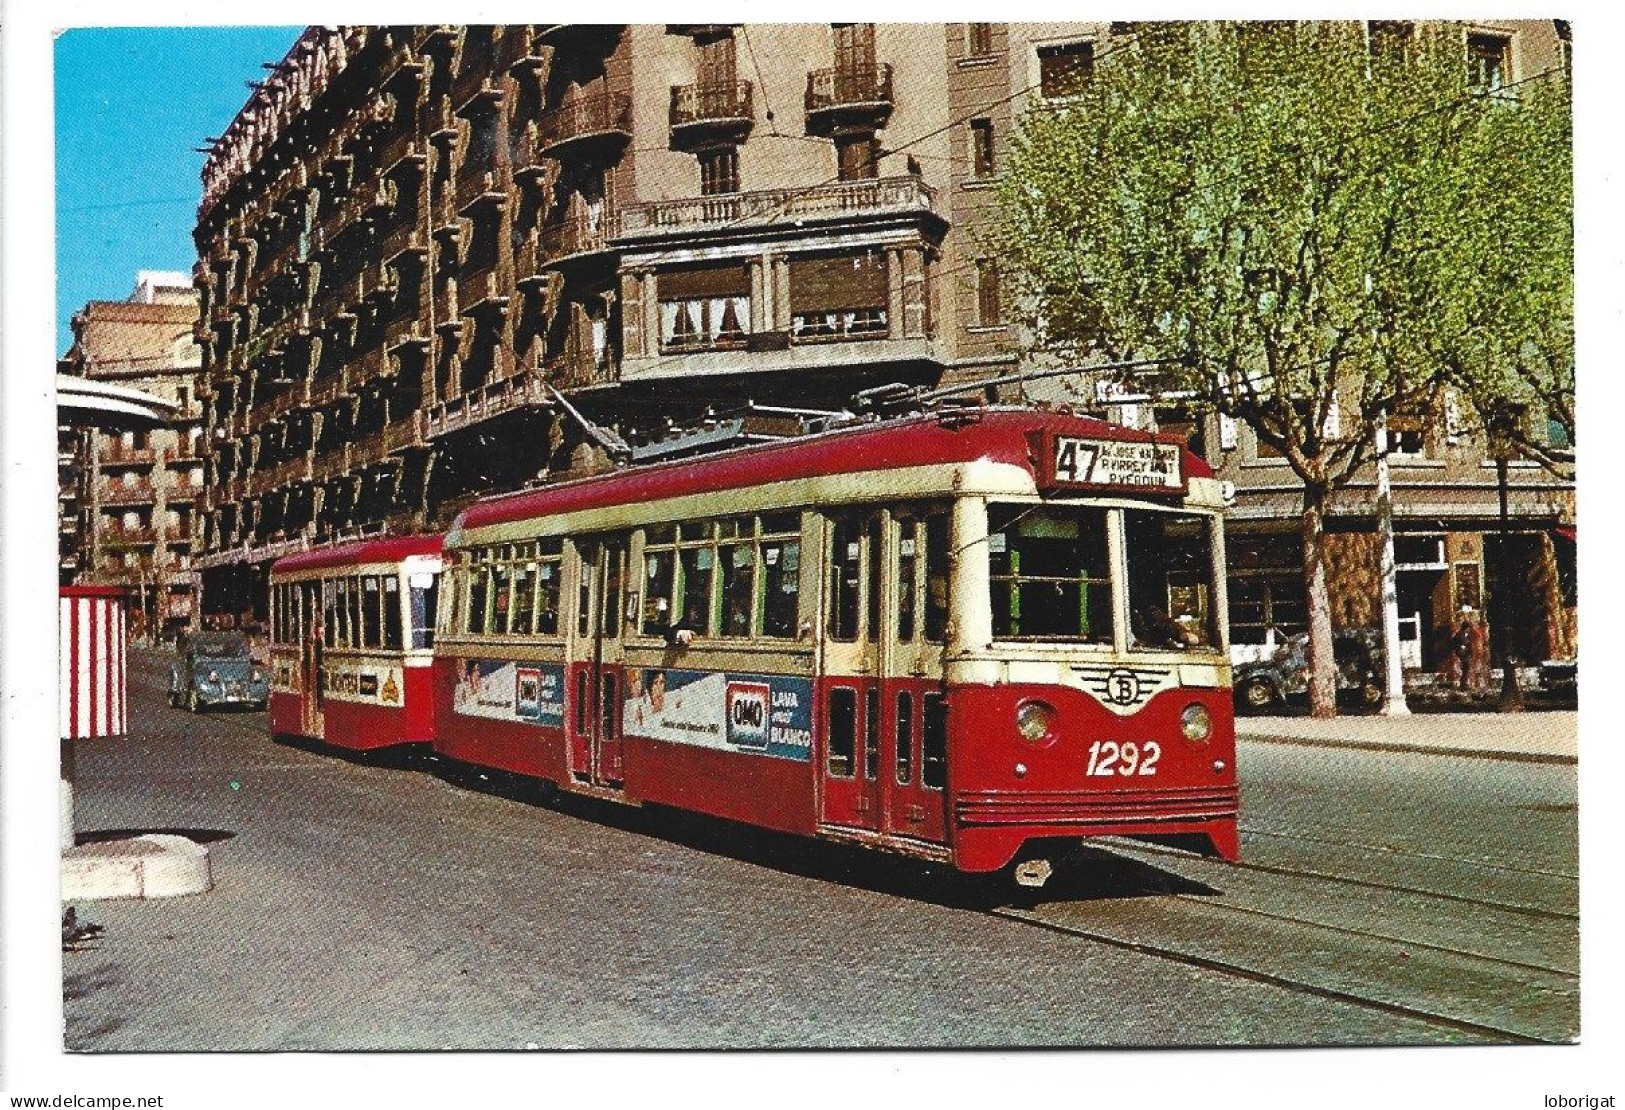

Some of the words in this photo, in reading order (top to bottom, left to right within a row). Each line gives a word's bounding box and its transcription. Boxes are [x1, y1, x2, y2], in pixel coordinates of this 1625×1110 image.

[1057, 442, 1099, 481] 47
[734, 699, 763, 727] OMO
[771, 692, 798, 708] LAVA
[771, 727, 811, 748] BLANCO
[1086, 740, 1162, 777] 1292
